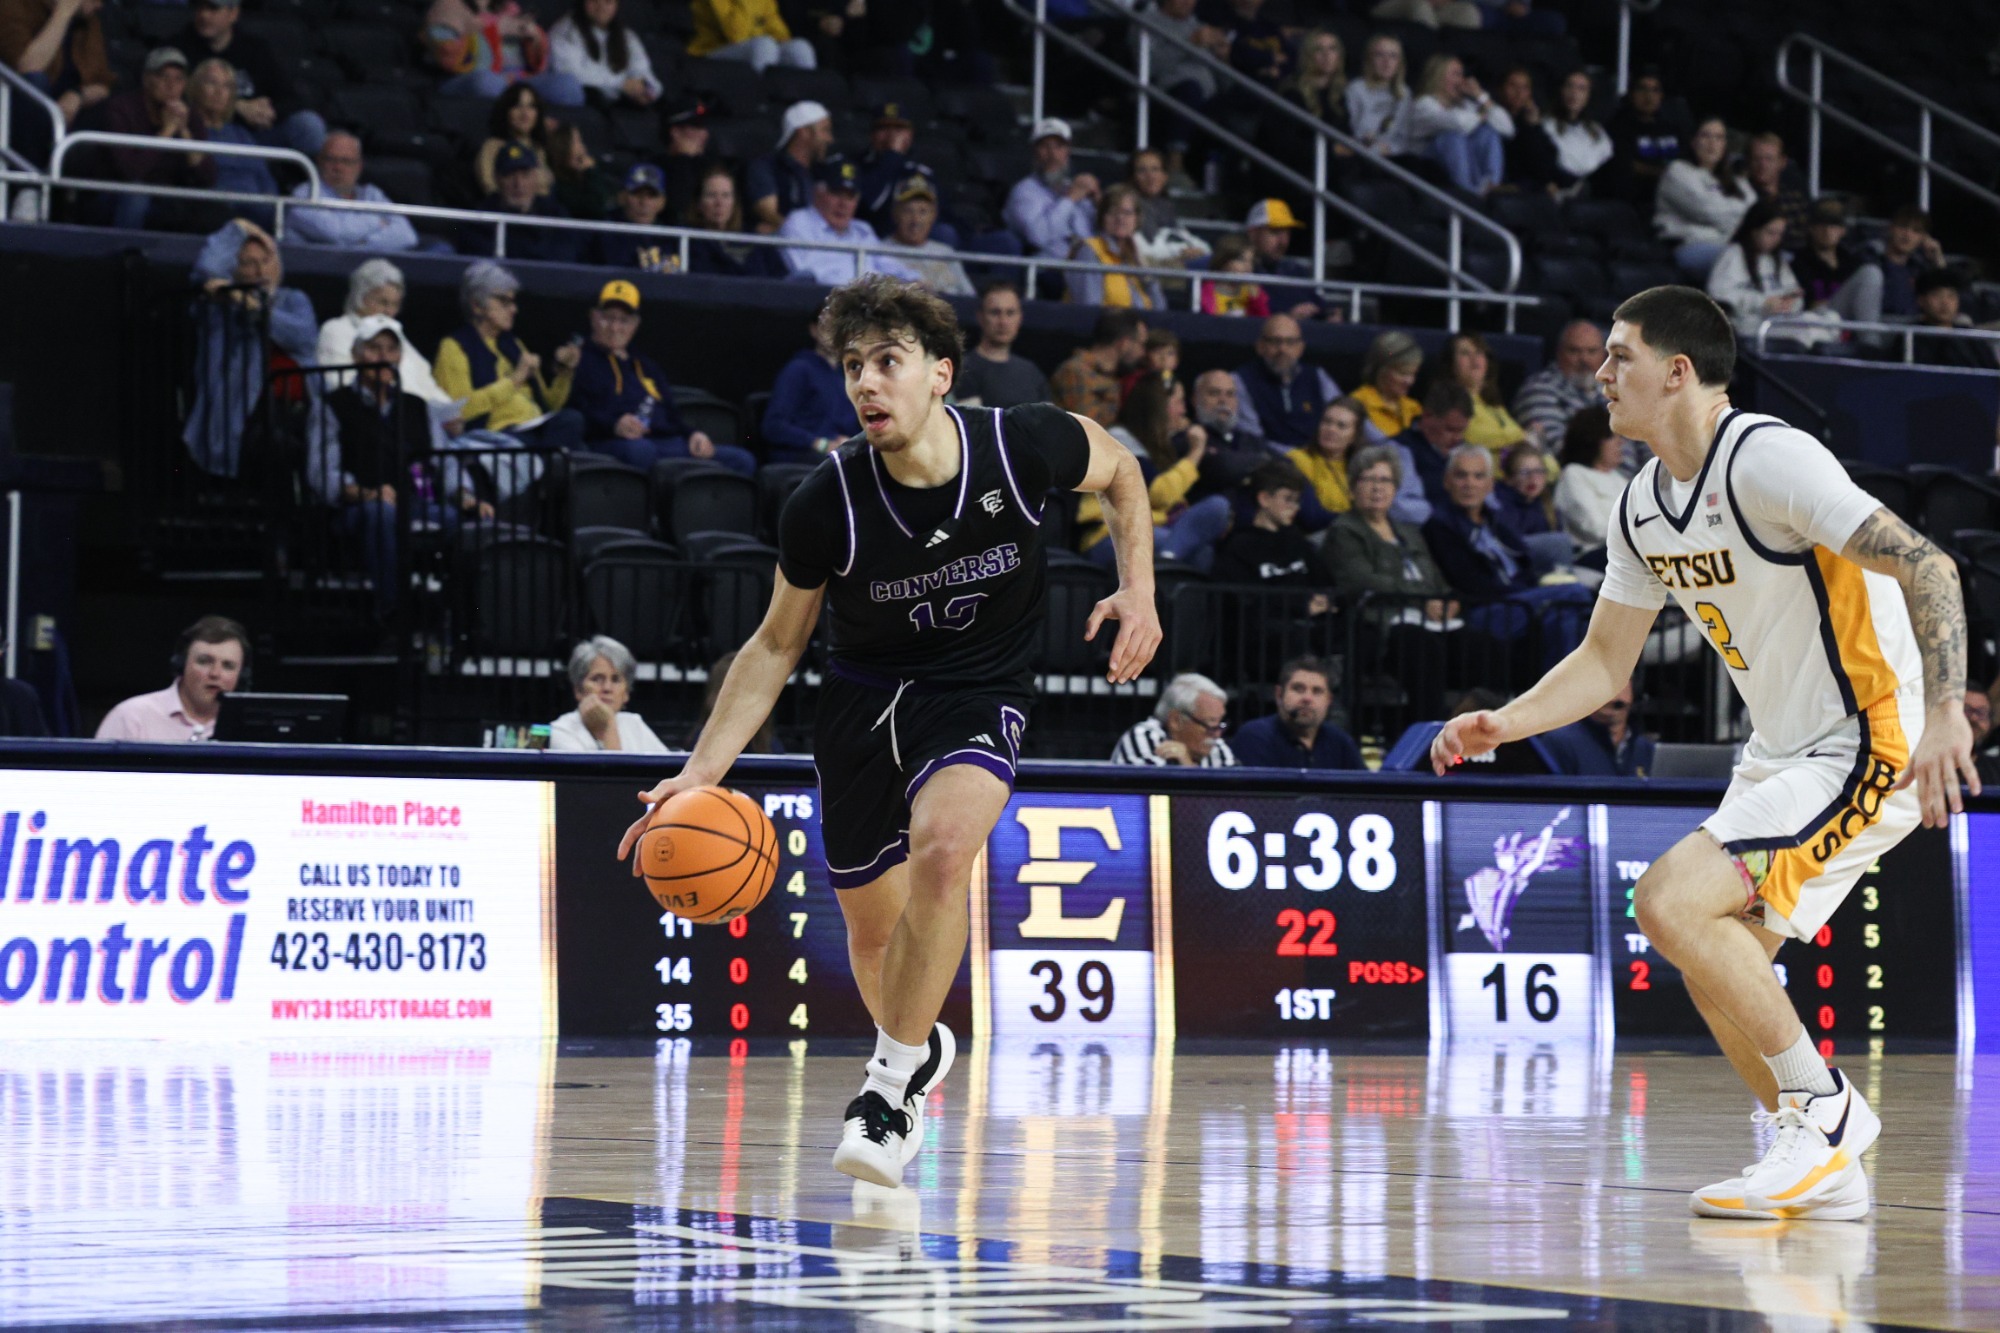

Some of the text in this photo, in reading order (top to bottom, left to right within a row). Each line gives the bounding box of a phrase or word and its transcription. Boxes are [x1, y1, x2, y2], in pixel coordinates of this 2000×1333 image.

[870, 542, 1021, 602] CONVERSE
[1645, 548, 1736, 590] ETSU
[1695, 601, 1749, 671] 2
[301, 799, 462, 827] Hamilton Place
[763, 793, 814, 820] PTS
[1811, 757, 1897, 864] BUCS
[788, 829, 807, 856] 0
[1207, 811, 1397, 892] 6:38
[300, 863, 461, 888] CALL US TODAY TO
[786, 870, 806, 897] 4
[288, 898, 474, 923] RESERVE YOUR UNIT!
[1862, 886, 1879, 911] 3
[659, 911, 693, 938] 11
[729, 914, 748, 938] 0
[789, 912, 808, 938] 7
[1276, 908, 1338, 957] 22
[1816, 923, 1880, 949] 0 5
[0, 912, 247, 1006] ontrol
[271, 931, 487, 972] 423-430-8173
[655, 957, 808, 985] 14 0 4
[1629, 960, 1651, 990] 2
[1816, 964, 1834, 989] 0
[1866, 964, 1883, 989] 2
[1029, 960, 1114, 1022] 39
[1274, 987, 1336, 1021] 1ST
[1483, 963, 1559, 1023] 16
[655, 1003, 809, 1031] 35 0 4
[1818, 1005, 1885, 1030] 0 2
